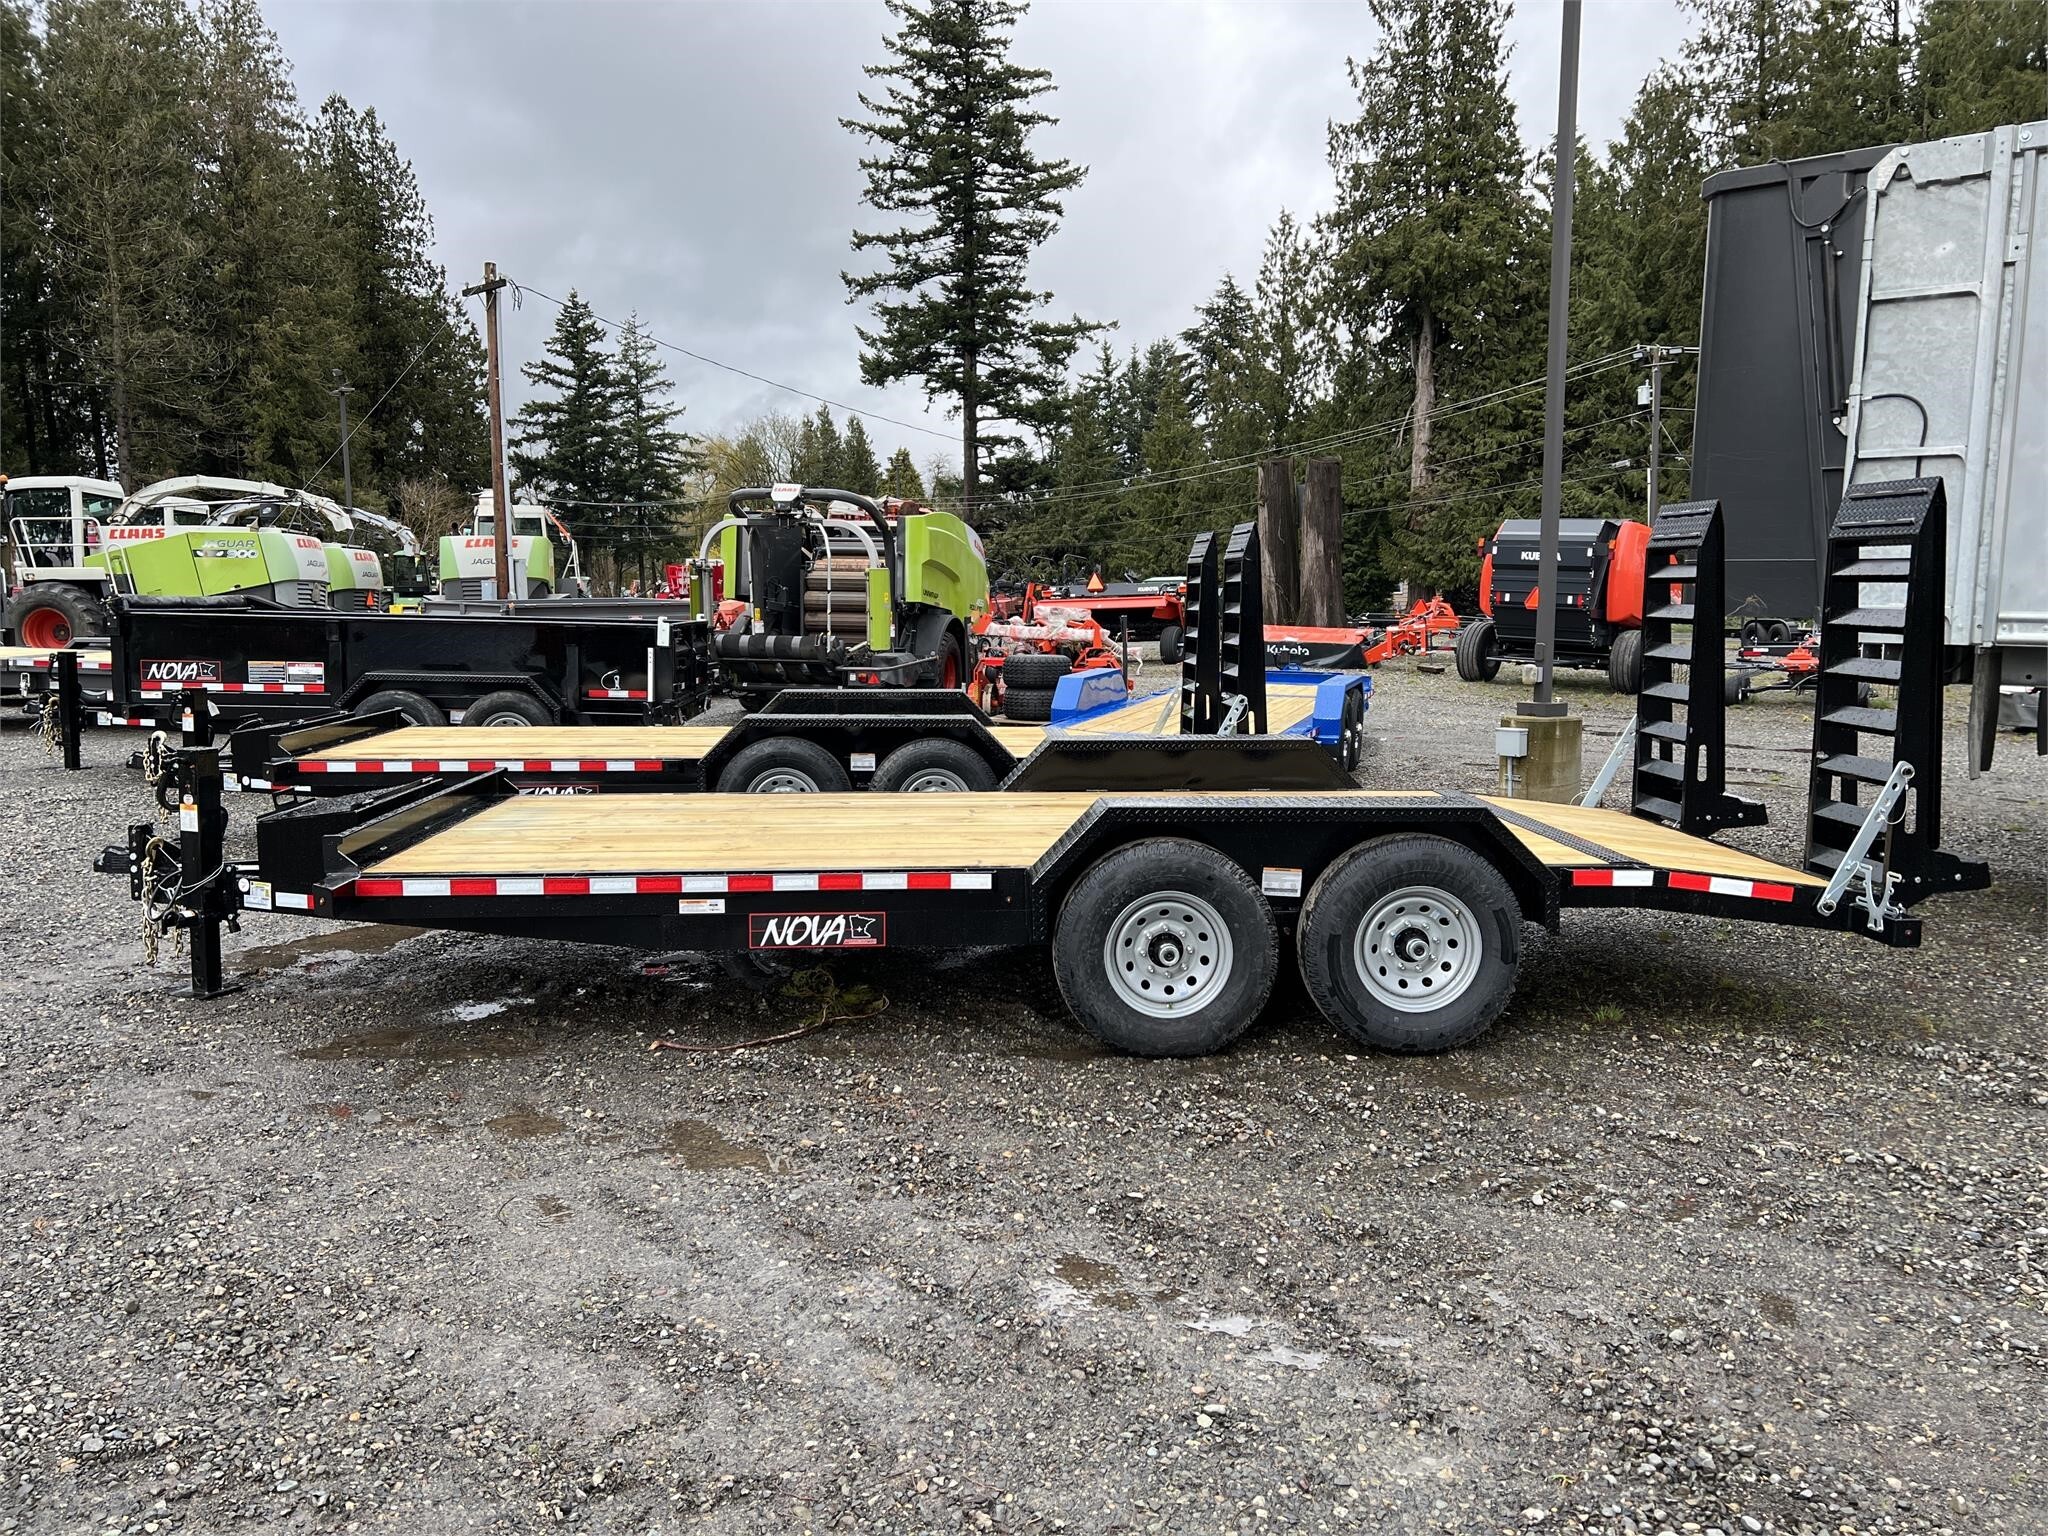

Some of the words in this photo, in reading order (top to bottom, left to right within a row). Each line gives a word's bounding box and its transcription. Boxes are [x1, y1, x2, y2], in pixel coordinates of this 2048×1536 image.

[109, 528, 166, 540] CLAAS
[207, 539, 256, 548] GUAR
[1520, 551, 1562, 561] KUBA
[147, 662, 198, 681] NOVA
[760, 914, 846, 947] NOVA
